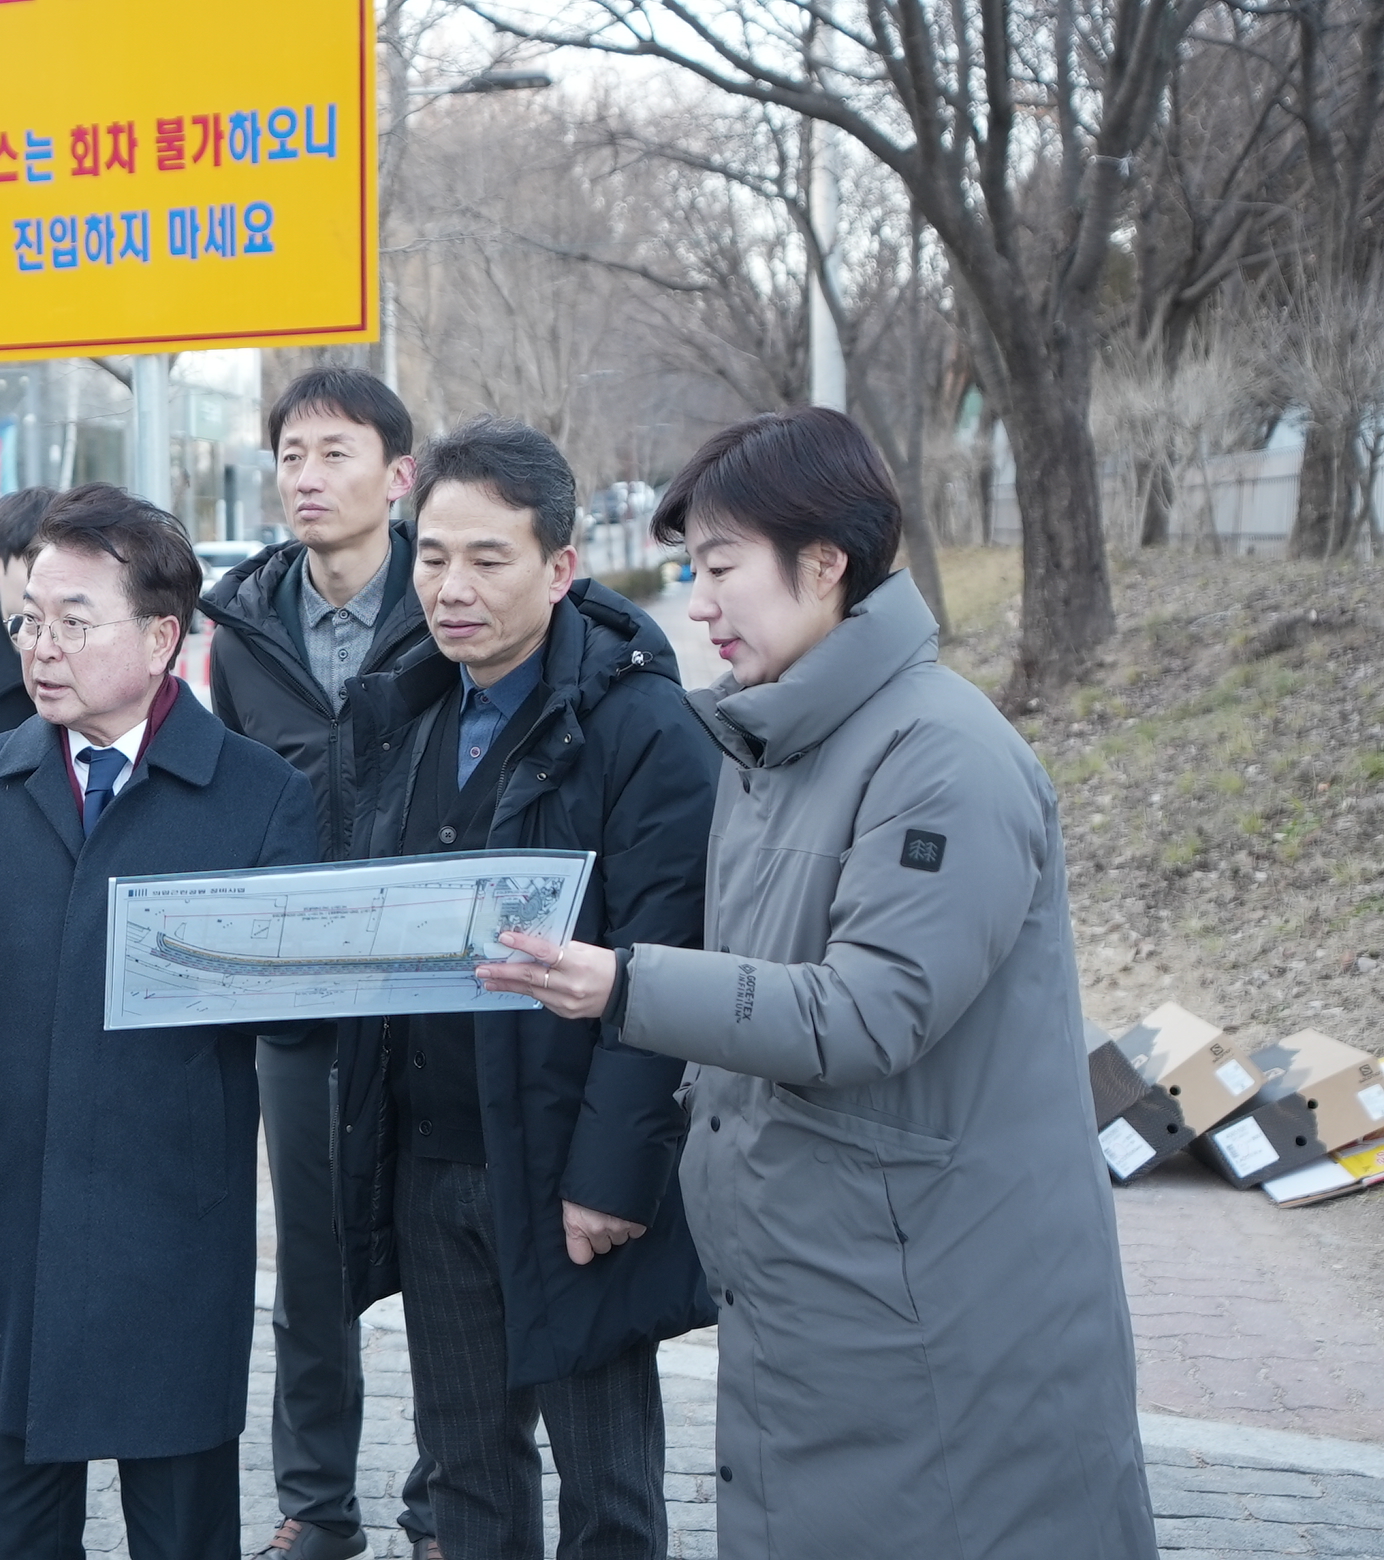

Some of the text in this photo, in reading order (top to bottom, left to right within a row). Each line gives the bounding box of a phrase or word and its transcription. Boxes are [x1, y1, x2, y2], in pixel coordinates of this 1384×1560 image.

[70, 120, 138, 177] 회차
[155, 103, 337, 172] 불가하오니
[14, 201, 275, 272] 진입하지 마세요
[742, 974, 757, 1021] GORE-TEX
